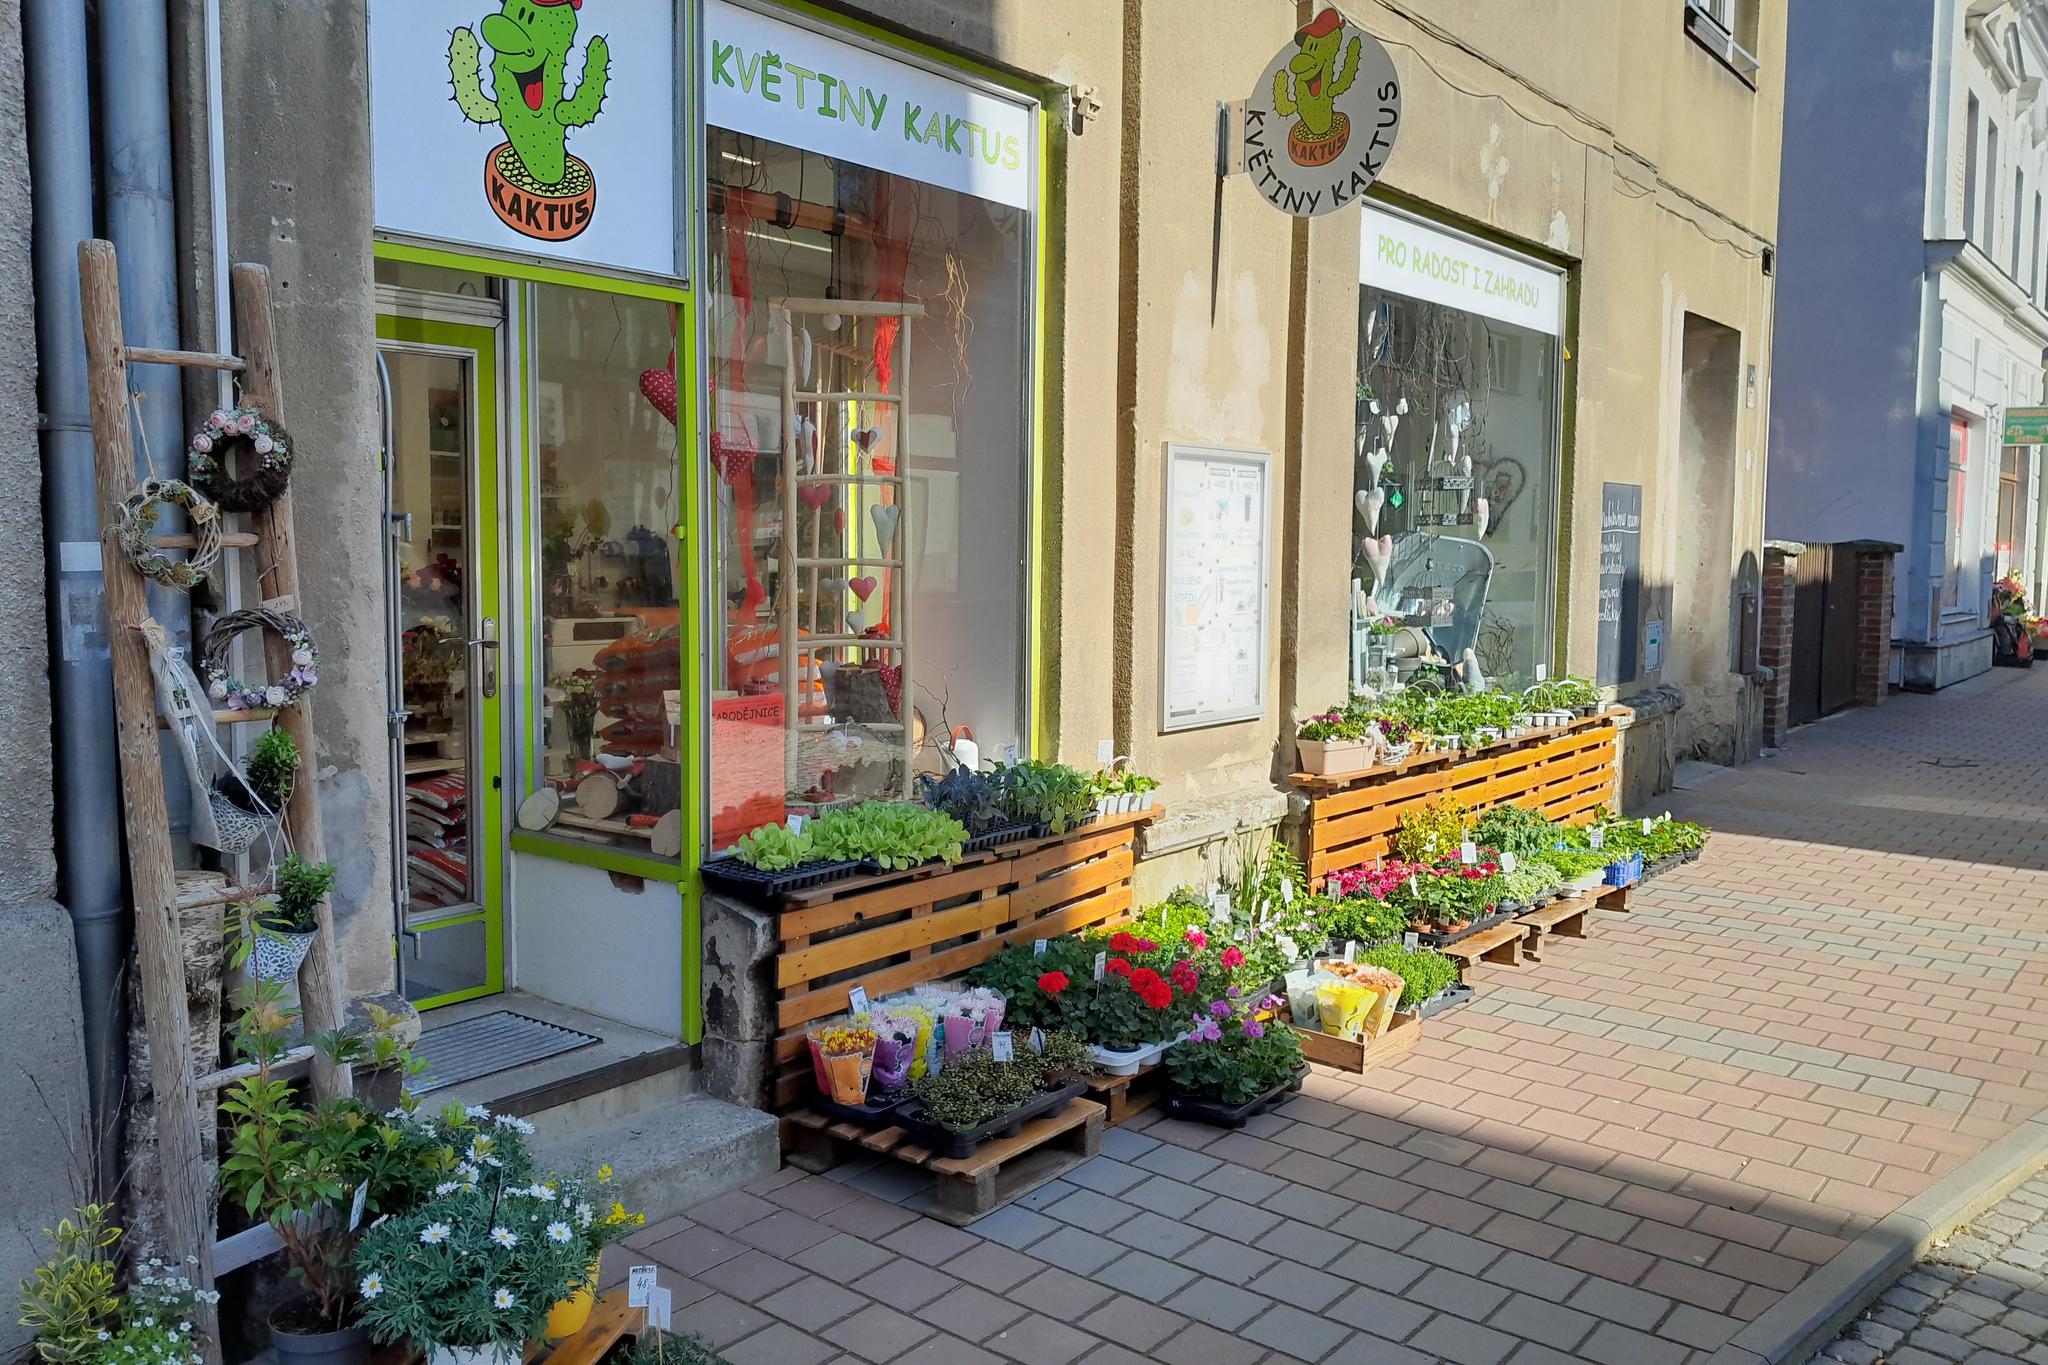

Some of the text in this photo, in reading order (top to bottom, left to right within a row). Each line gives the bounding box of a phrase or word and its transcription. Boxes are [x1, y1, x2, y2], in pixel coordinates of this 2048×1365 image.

[712, 39, 1021, 170] KVĚTINY KAKTUS
[1245, 80, 1399, 215] KVĚTINY KAKTUS
[1291, 134, 1347, 162] KAKTUS
[491, 174, 591, 232] KAKTUS
[1377, 233, 1540, 309] PRO RADOST I ZAHRADU
